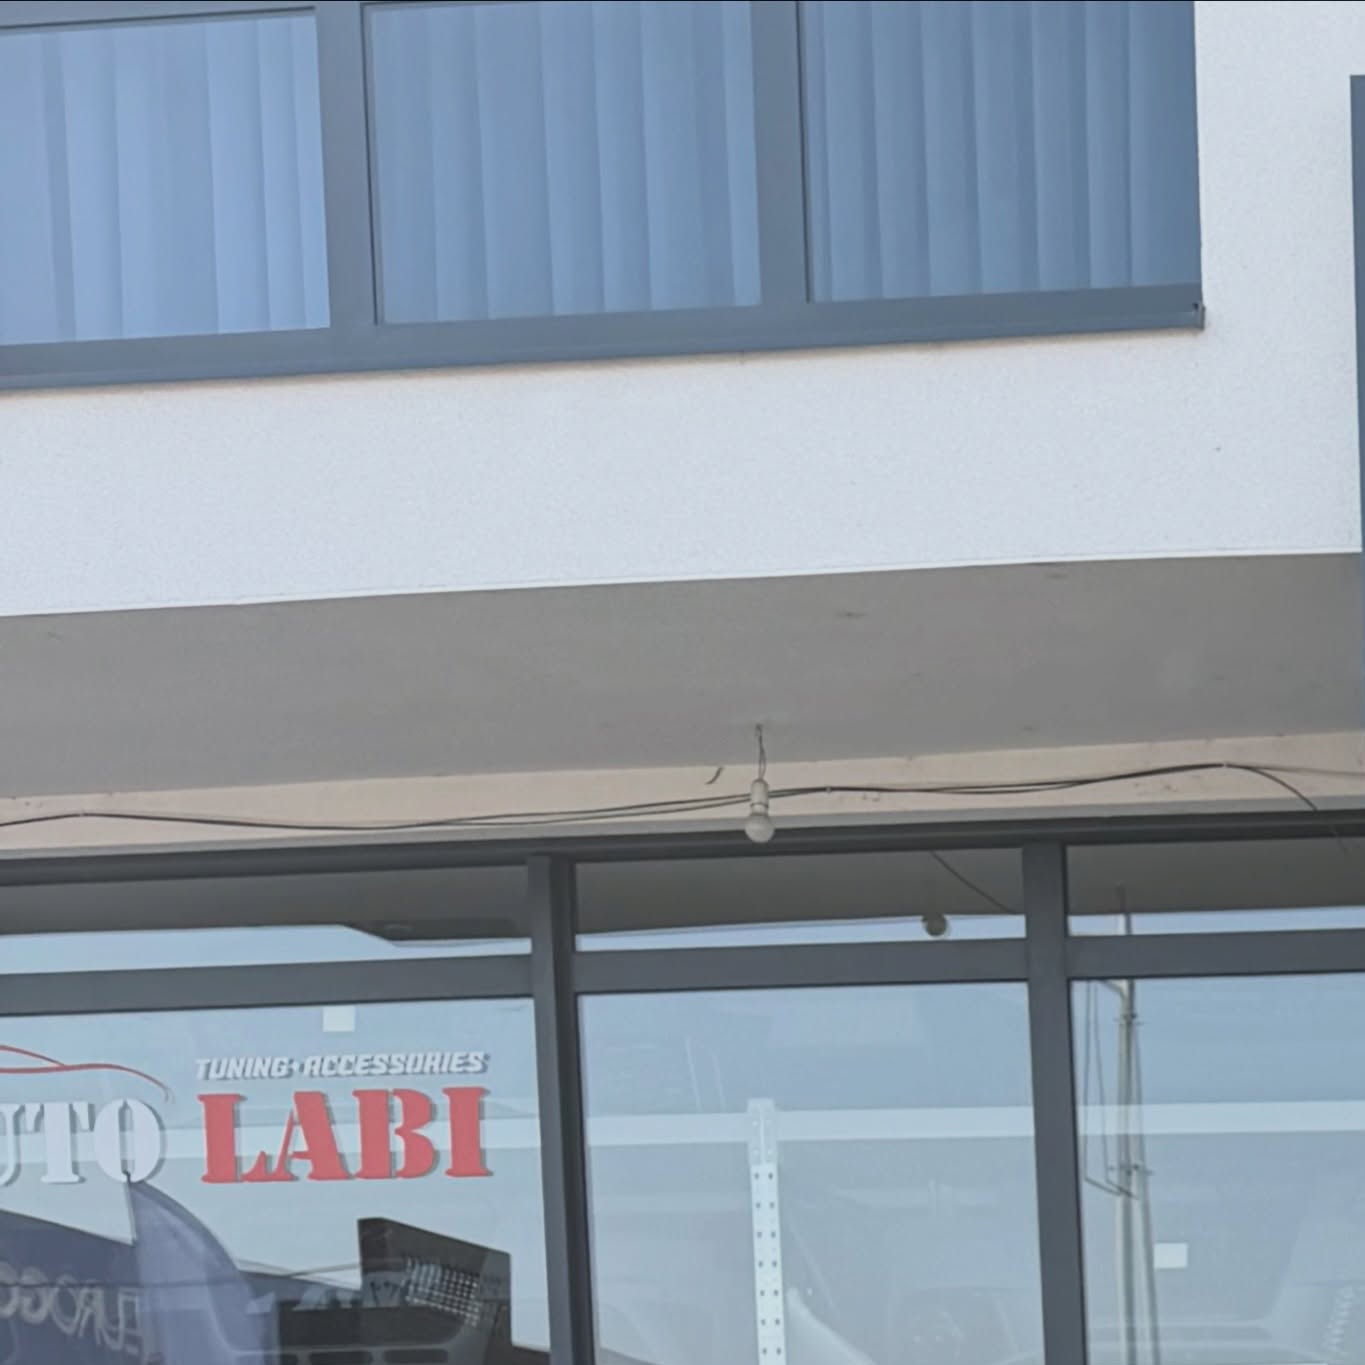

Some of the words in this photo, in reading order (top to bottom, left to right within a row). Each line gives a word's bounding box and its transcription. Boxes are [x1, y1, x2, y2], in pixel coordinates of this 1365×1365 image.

[195, 1056, 294, 1080] TUNING
[303, 1052, 490, 1077] ACCESSORIES
[198, 1087, 494, 1184] LABI
